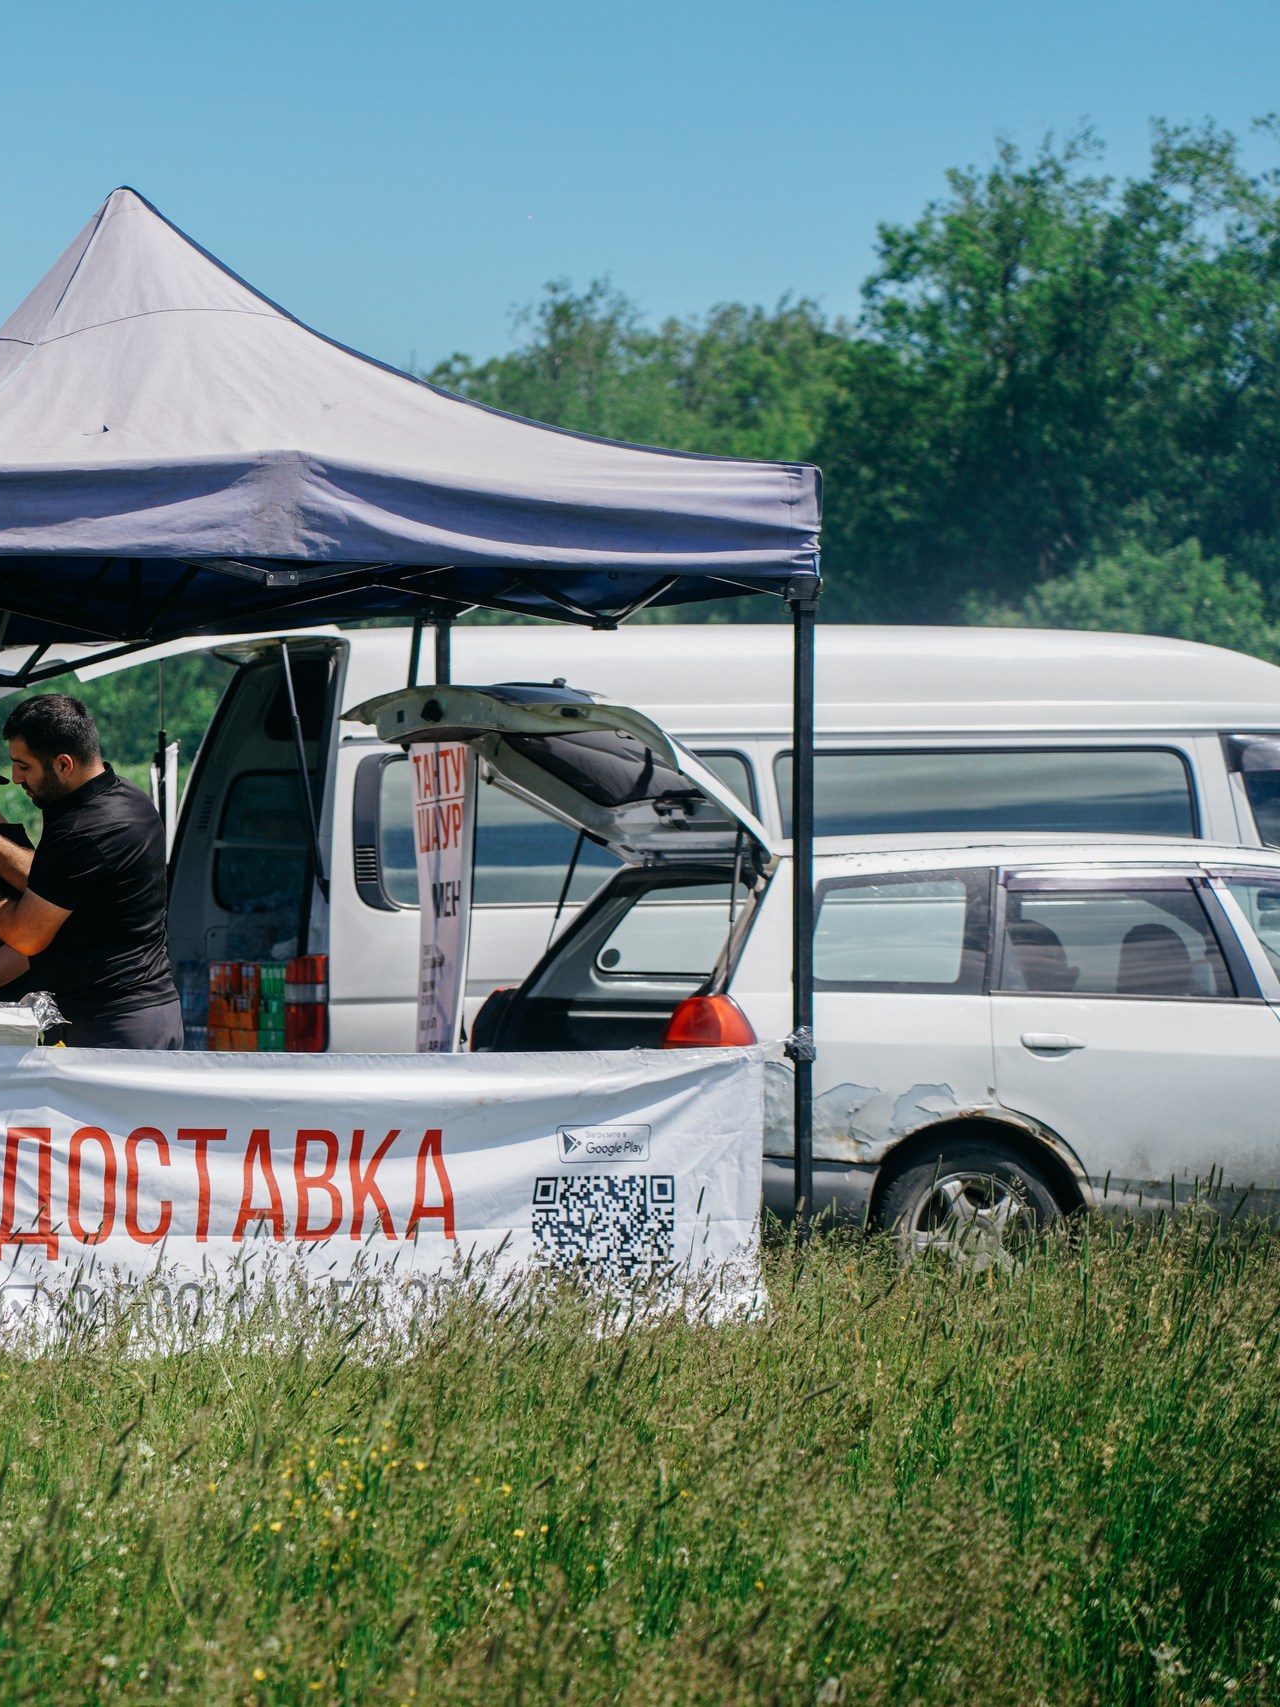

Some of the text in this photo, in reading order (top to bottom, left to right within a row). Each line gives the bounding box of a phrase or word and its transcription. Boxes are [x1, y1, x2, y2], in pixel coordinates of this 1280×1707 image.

[417, 802, 465, 853] ШАУР
[585, 1141, 644, 1156] Google Play
